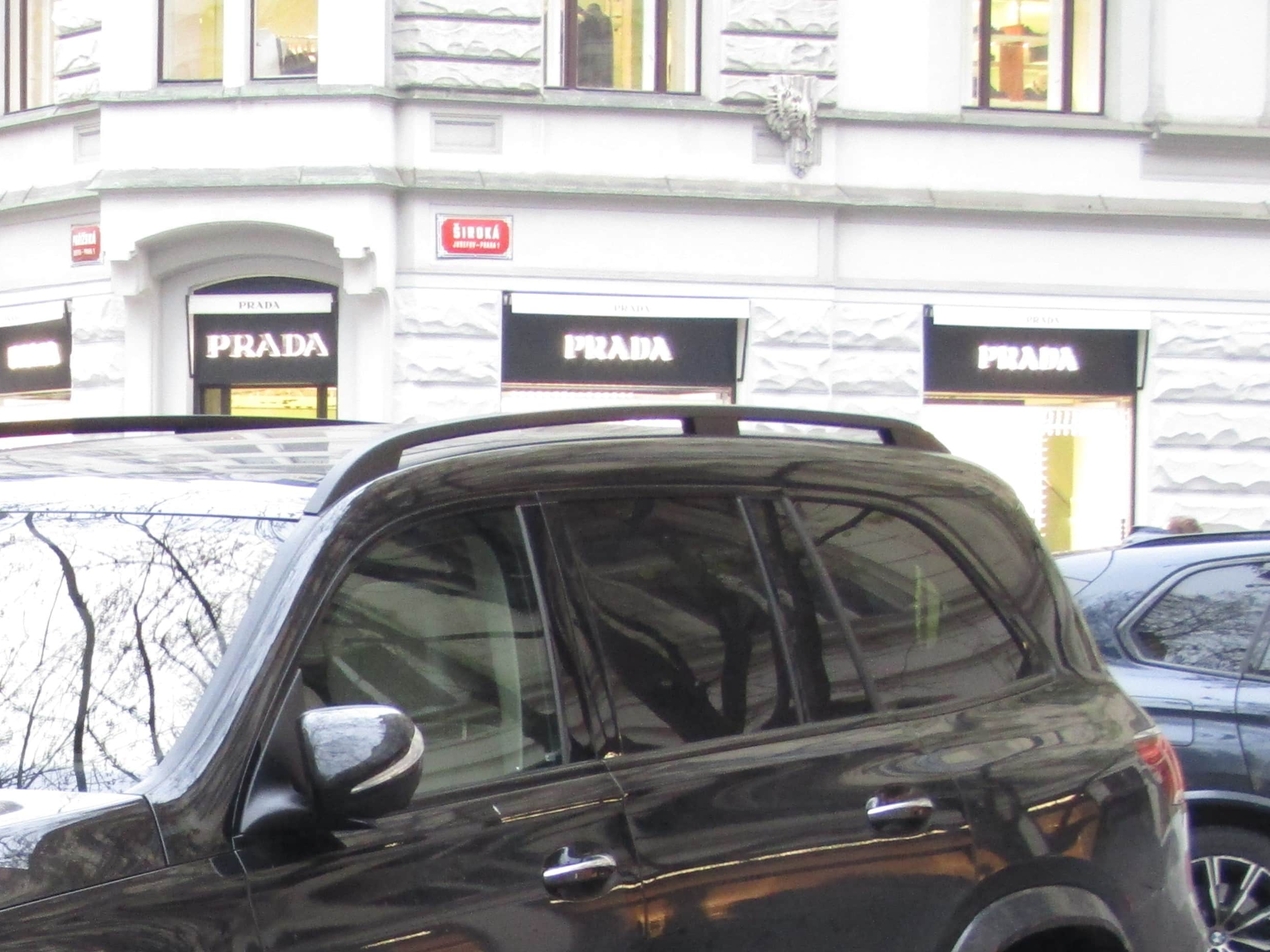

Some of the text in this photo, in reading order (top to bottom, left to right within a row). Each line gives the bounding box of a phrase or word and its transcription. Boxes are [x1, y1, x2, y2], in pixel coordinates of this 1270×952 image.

[452, 222, 500, 239] ŠIROKÁ
[238, 301, 280, 309] PRADA
[614, 304, 651, 313] PRADA
[205, 332, 329, 358] PRADA
[563, 334, 674, 361] PRADA
[977, 344, 1080, 371] PRADA
